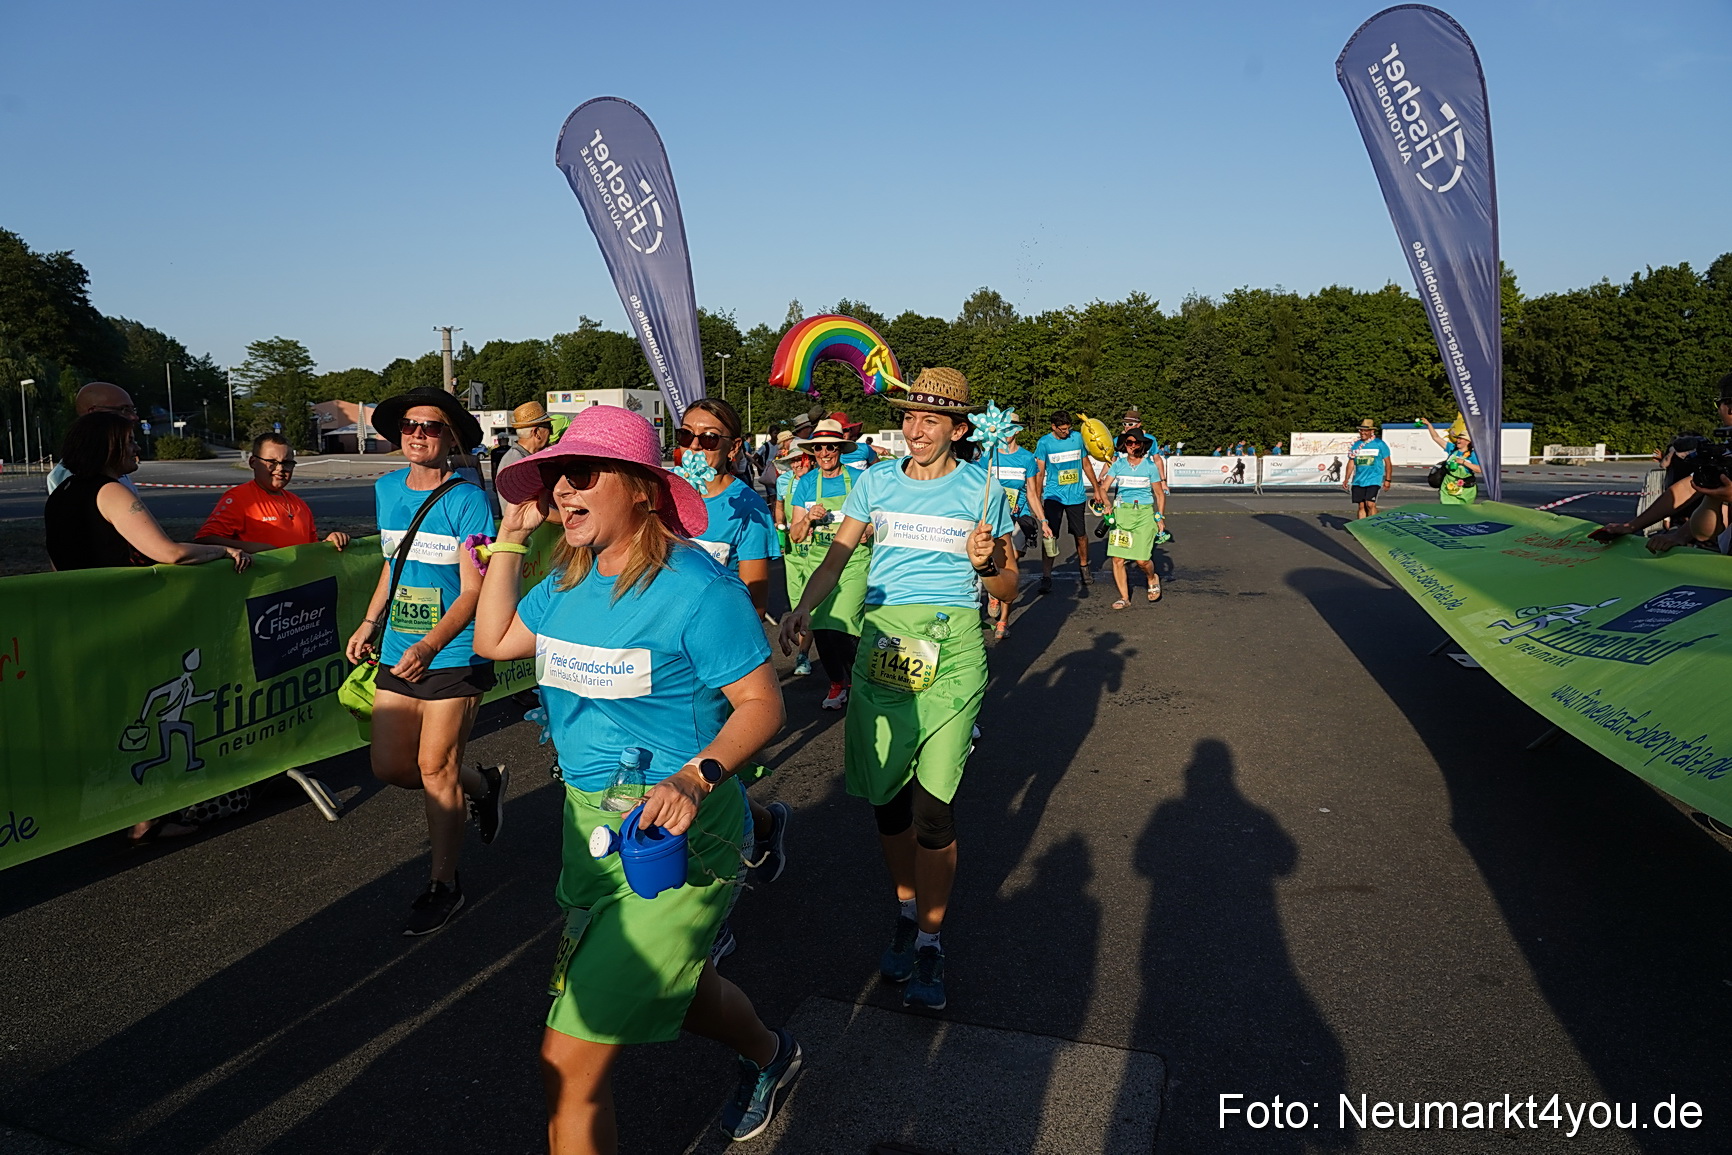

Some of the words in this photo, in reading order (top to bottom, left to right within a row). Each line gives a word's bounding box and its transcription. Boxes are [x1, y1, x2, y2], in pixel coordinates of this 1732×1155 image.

[819, 532, 837, 541] 143
[893, 530, 902, 538] im
[902, 532, 920, 541] Haus
[929, 535, 954, 544] Marien
[894, 521, 914, 532] Freie
[915, 523, 967, 538] Grundschule
[799, 543, 810, 551] 14
[270, 604, 326, 634] Fischer
[396, 601, 430, 619] 1436
[276, 620, 320, 641] AUTOMOBILE
[1537, 620, 1719, 665] firmenlauf
[550, 652, 567, 668] Freie
[568, 657, 635, 675] Grundschule
[870, 651, 879, 677] WALK
[879, 651, 924, 678] 1442
[1514, 643, 1577, 667] neumarkt
[497, 660, 536, 690] rpfalz.
[549, 667, 558, 678] im
[557, 668, 572, 682] Haus
[572, 672, 581, 682] St.
[580, 674, 613, 687] Marien
[880, 670, 897, 680] Frank
[922, 664, 932, 688] 2022
[218, 704, 314, 757] neumarkt
